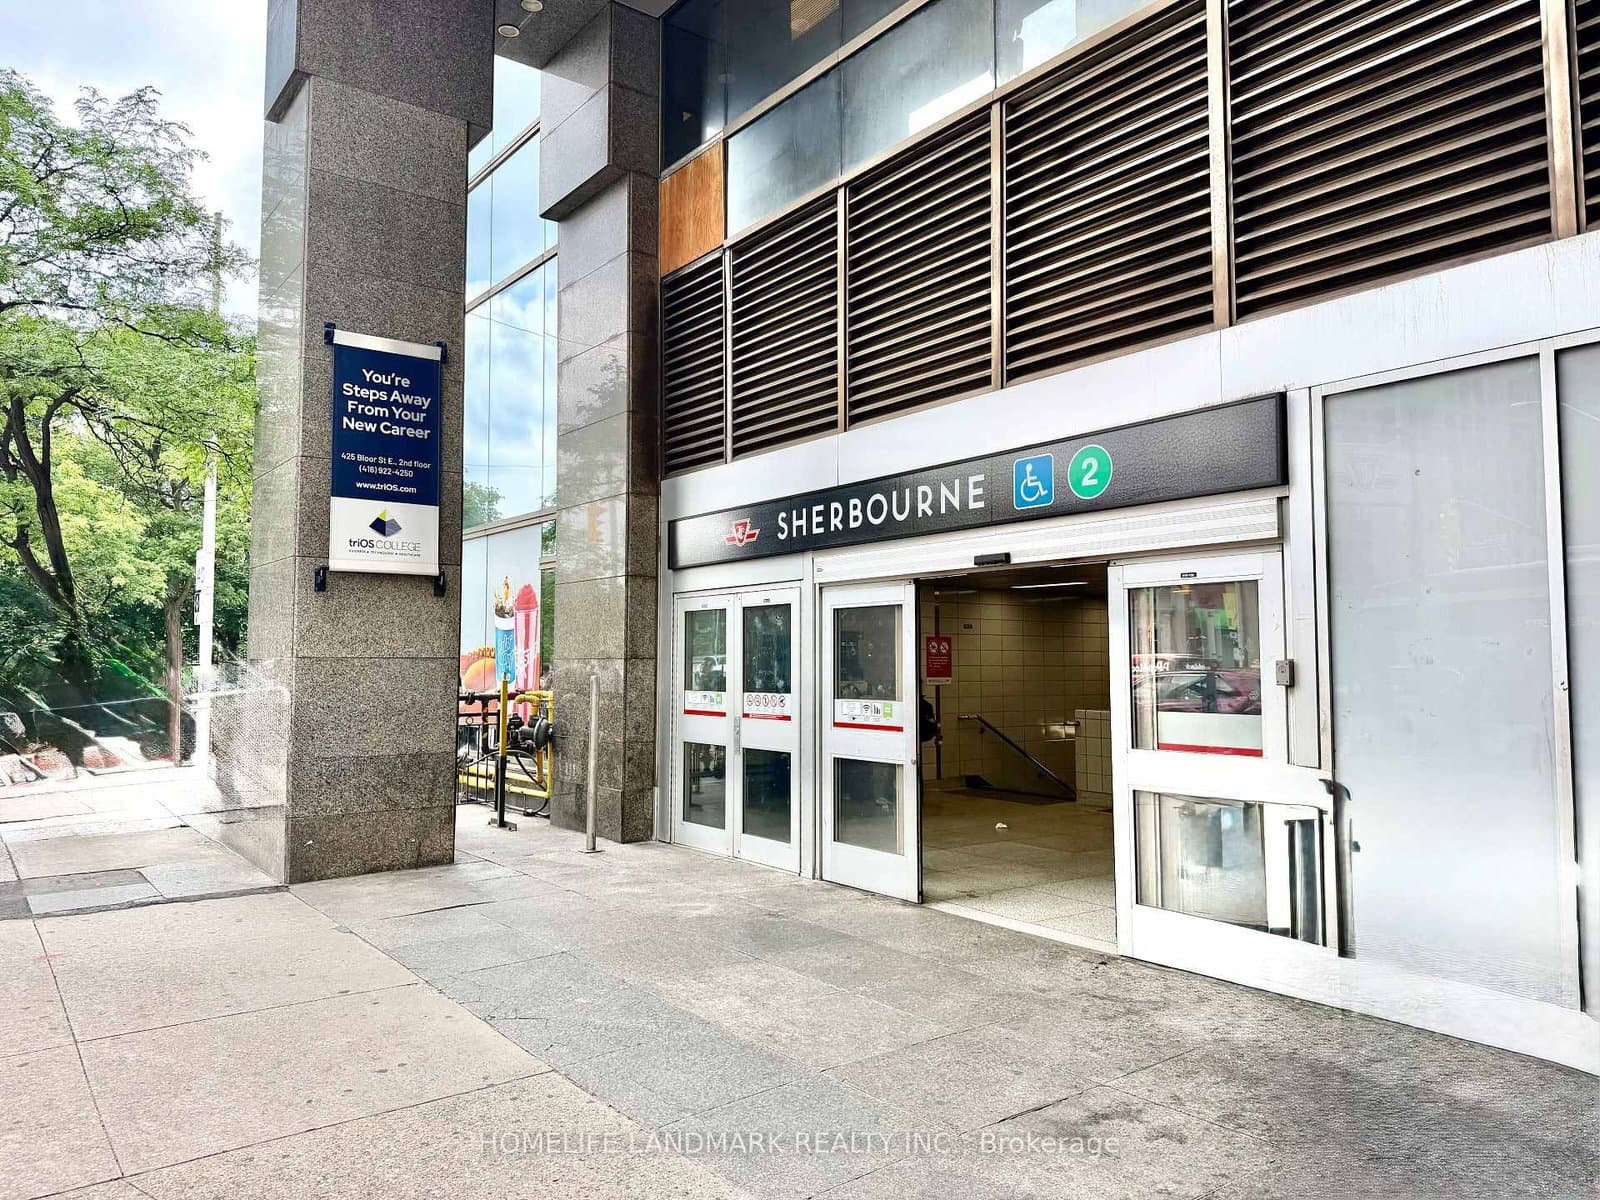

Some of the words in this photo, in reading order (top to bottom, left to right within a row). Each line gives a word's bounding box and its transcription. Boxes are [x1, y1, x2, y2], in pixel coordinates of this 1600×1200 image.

[342, 382, 388, 402] Steps
[390, 390, 431, 409] Away
[347, 400, 389, 418] From
[391, 406, 427, 422] Your
[342, 416, 377, 432] New
[379, 421, 431, 439] Career
[341, 452, 356, 461] 425
[356, 453, 377, 463] Bloor
[378, 456, 387, 465] St
[398, 458, 413, 468] 2nd
[413, 460, 431, 469] floor
[1080, 456, 1099, 486] 2
[355, 481, 417, 494] www.triOS.com
[776, 473, 986, 540] SHERBOURNE
